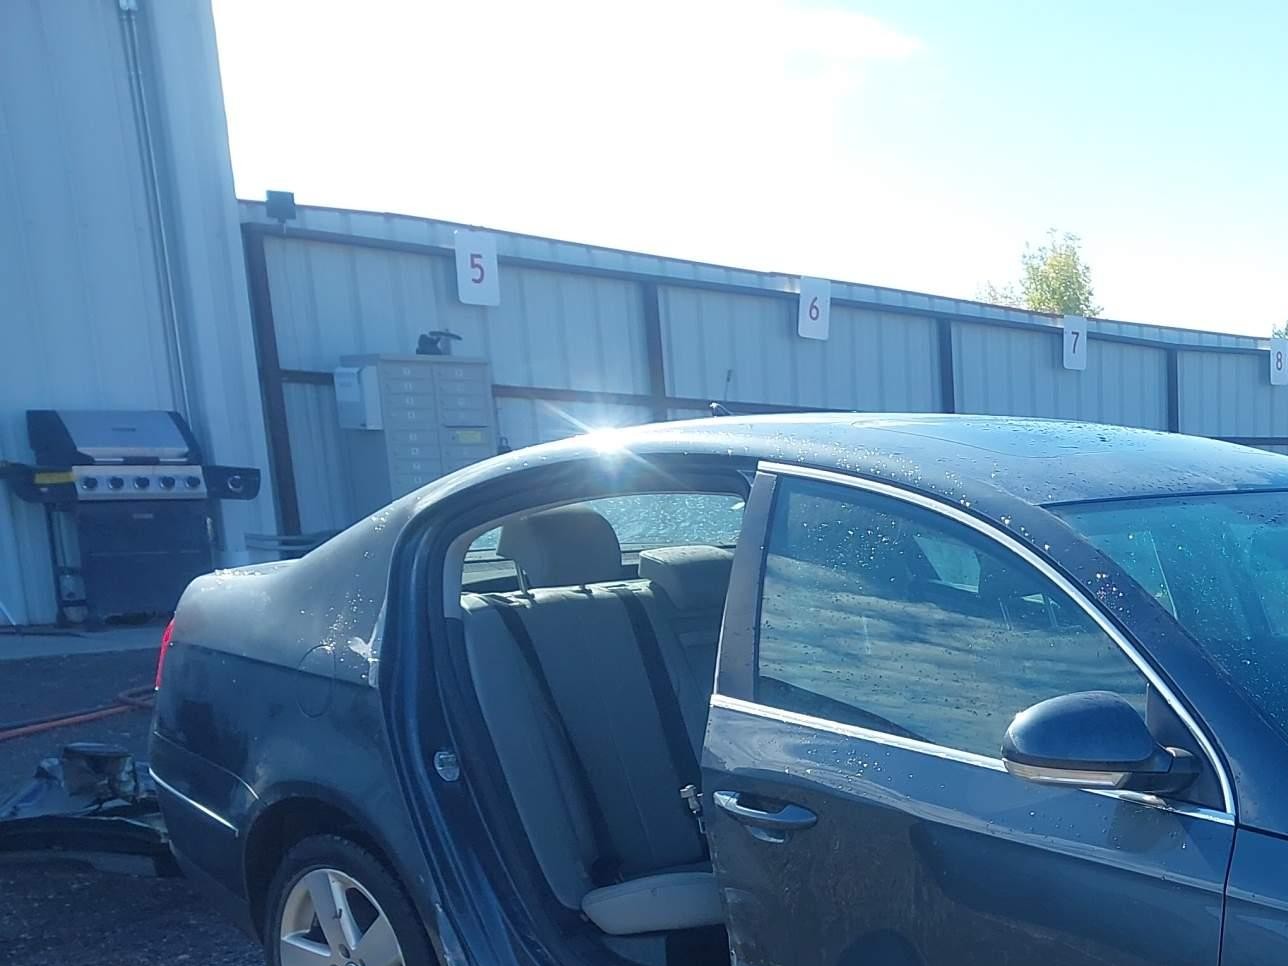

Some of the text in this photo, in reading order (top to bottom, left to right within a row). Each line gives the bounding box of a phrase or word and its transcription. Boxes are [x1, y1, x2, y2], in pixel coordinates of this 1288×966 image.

[469, 253, 485, 284] 5
[808, 296, 820, 321] 6
[1071, 331, 1080, 354] 7
[1275, 351, 1283, 371] 8
